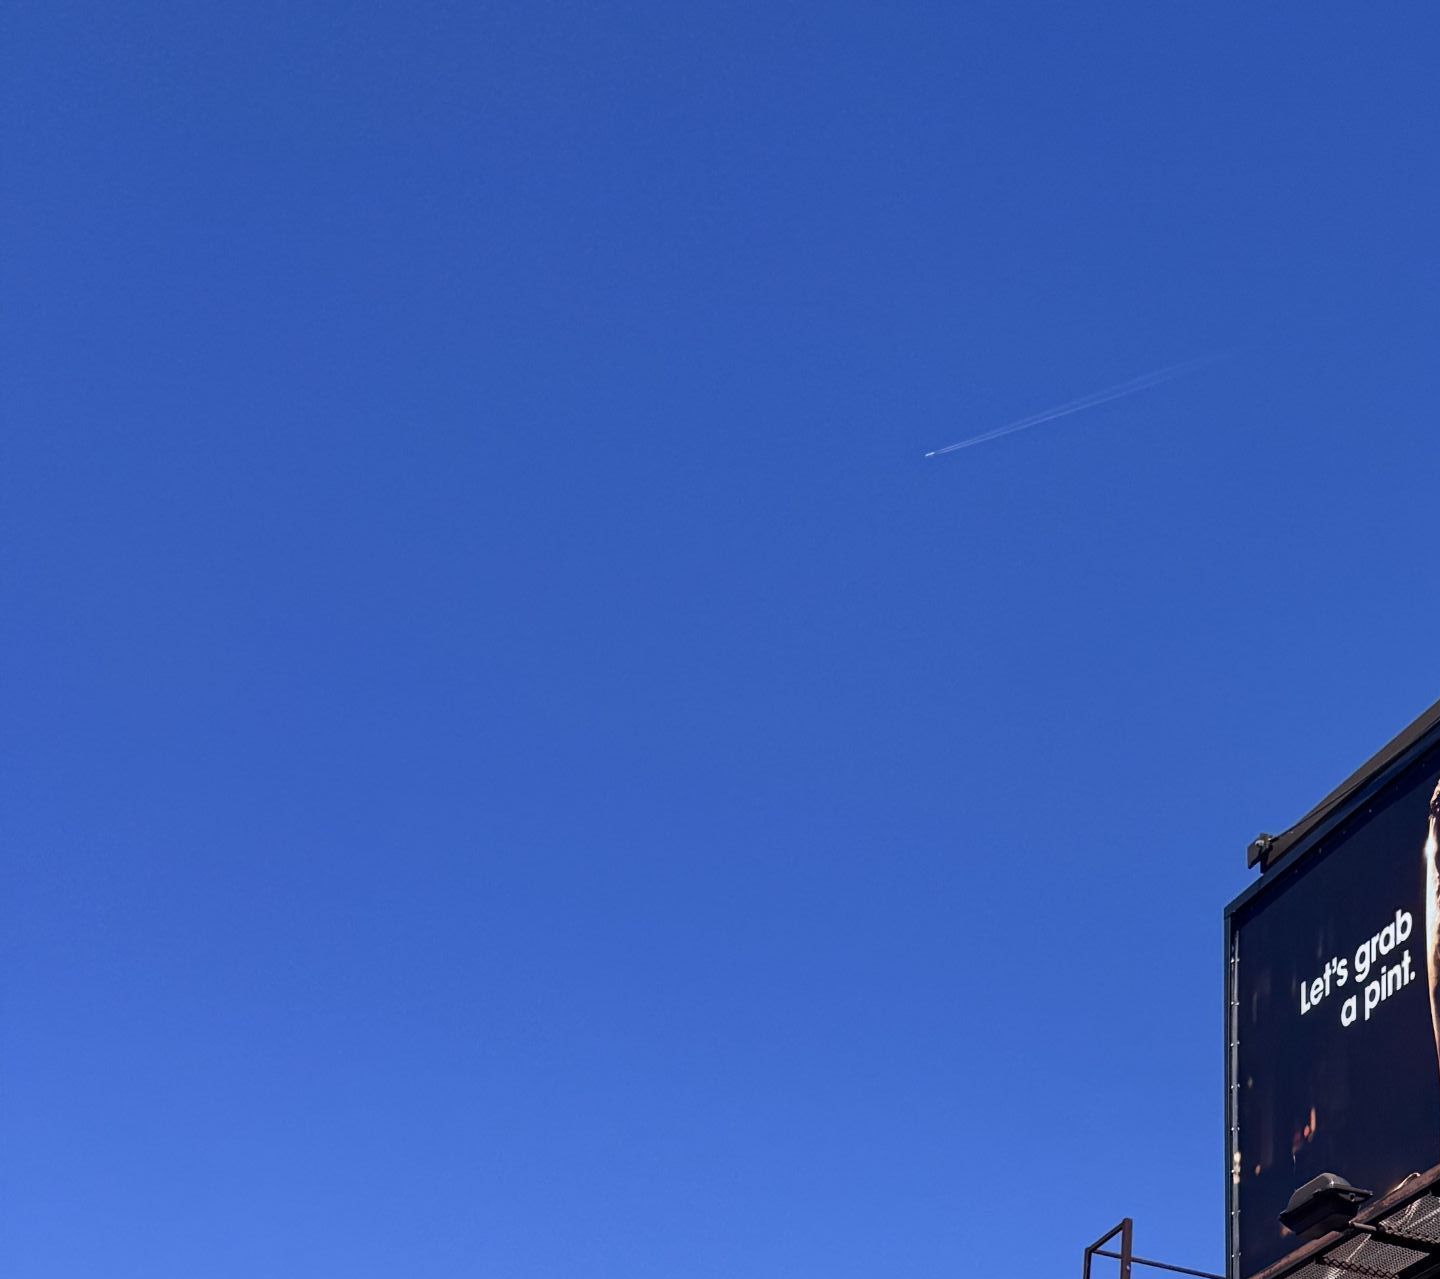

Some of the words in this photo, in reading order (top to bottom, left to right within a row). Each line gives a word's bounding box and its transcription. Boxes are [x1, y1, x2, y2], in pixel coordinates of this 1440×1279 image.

[1300, 956, 1349, 1015] Let's
[1354, 908, 1413, 982] grab
[1340, 995, 1357, 1027] a
[1364, 949, 1416, 1021] pint.
